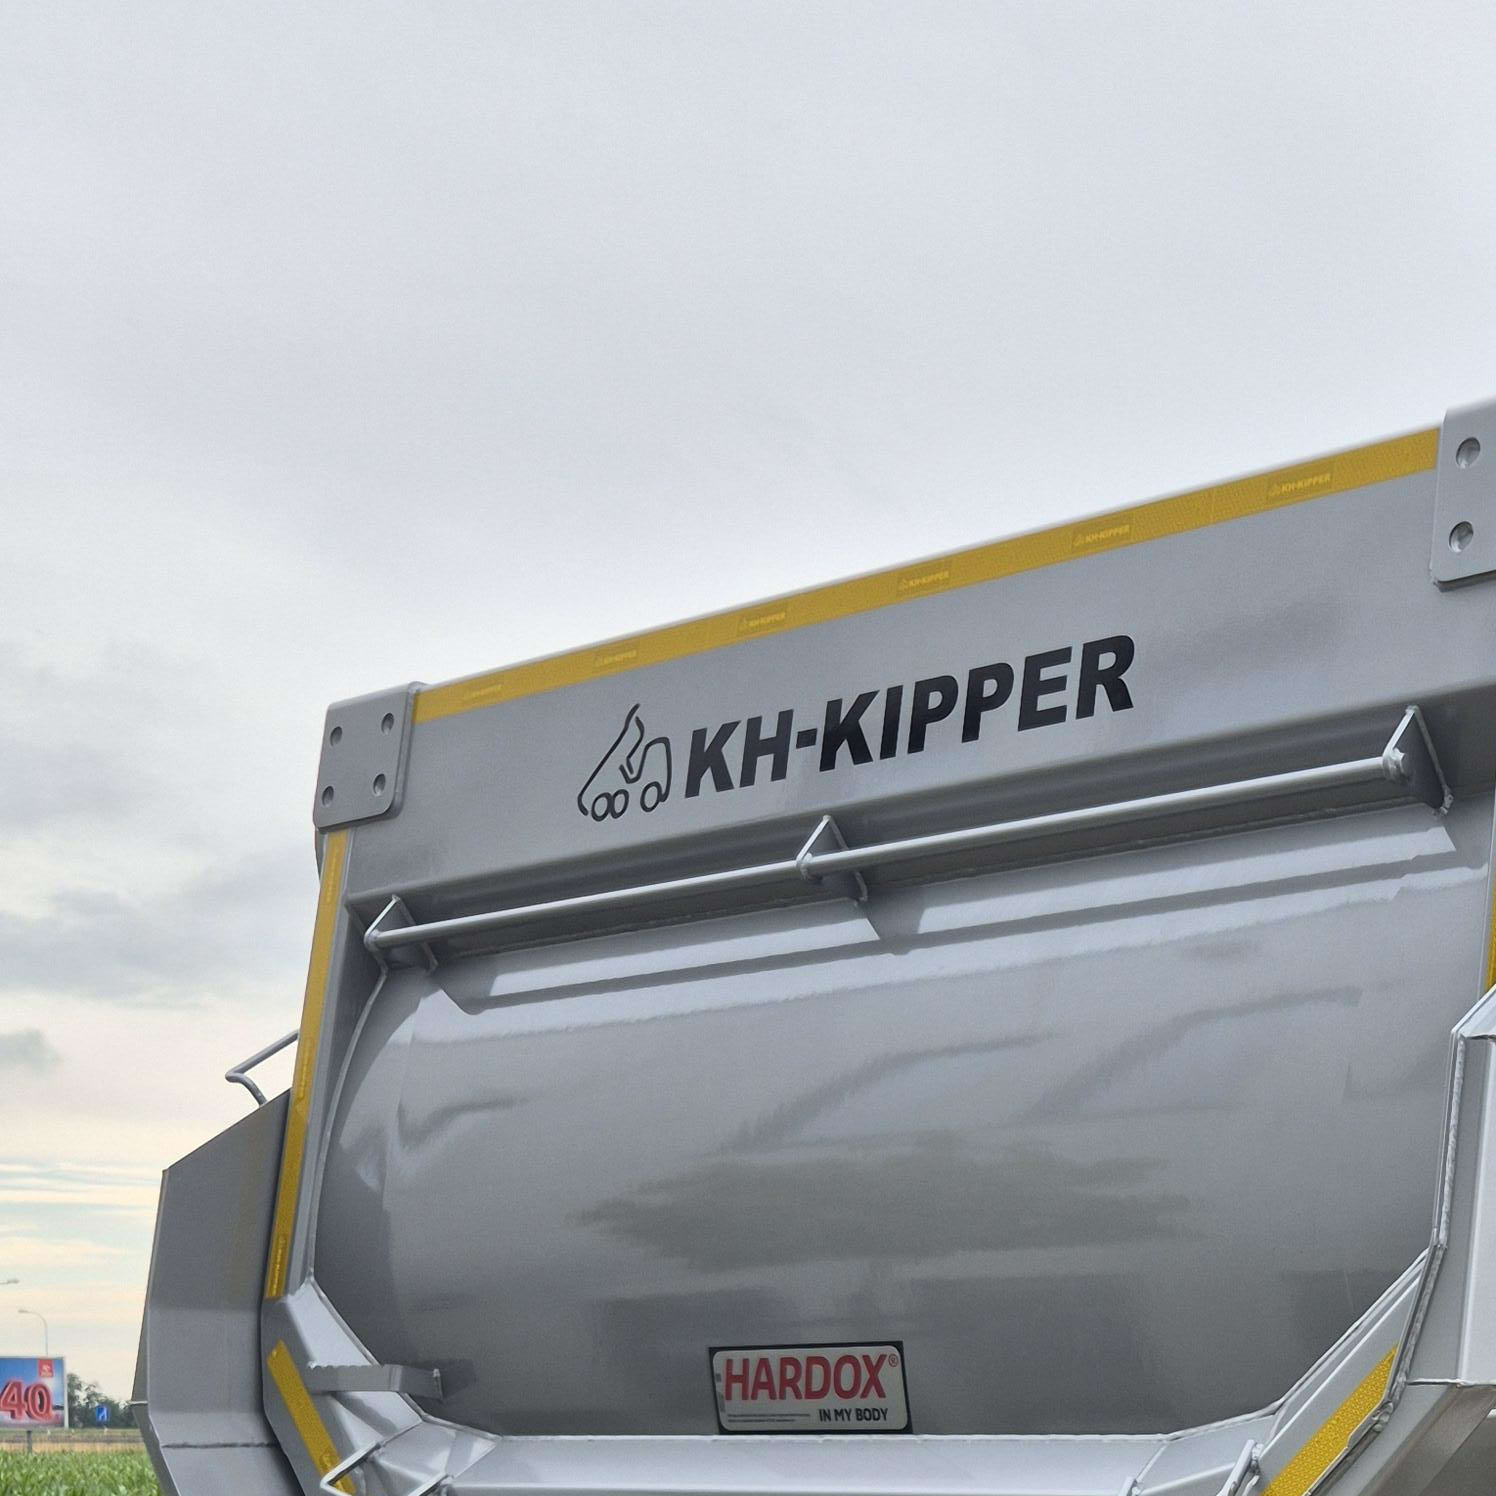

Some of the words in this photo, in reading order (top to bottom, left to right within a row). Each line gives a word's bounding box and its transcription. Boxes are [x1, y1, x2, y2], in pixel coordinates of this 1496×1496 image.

[684, 634, 1136, 798] KH-KIPPER
[0, 1380, 52, 1420] 40
[819, 1408, 832, 1422] IN
[835, 1408, 853, 1422] MY
[856, 1407, 888, 1421] BODY
